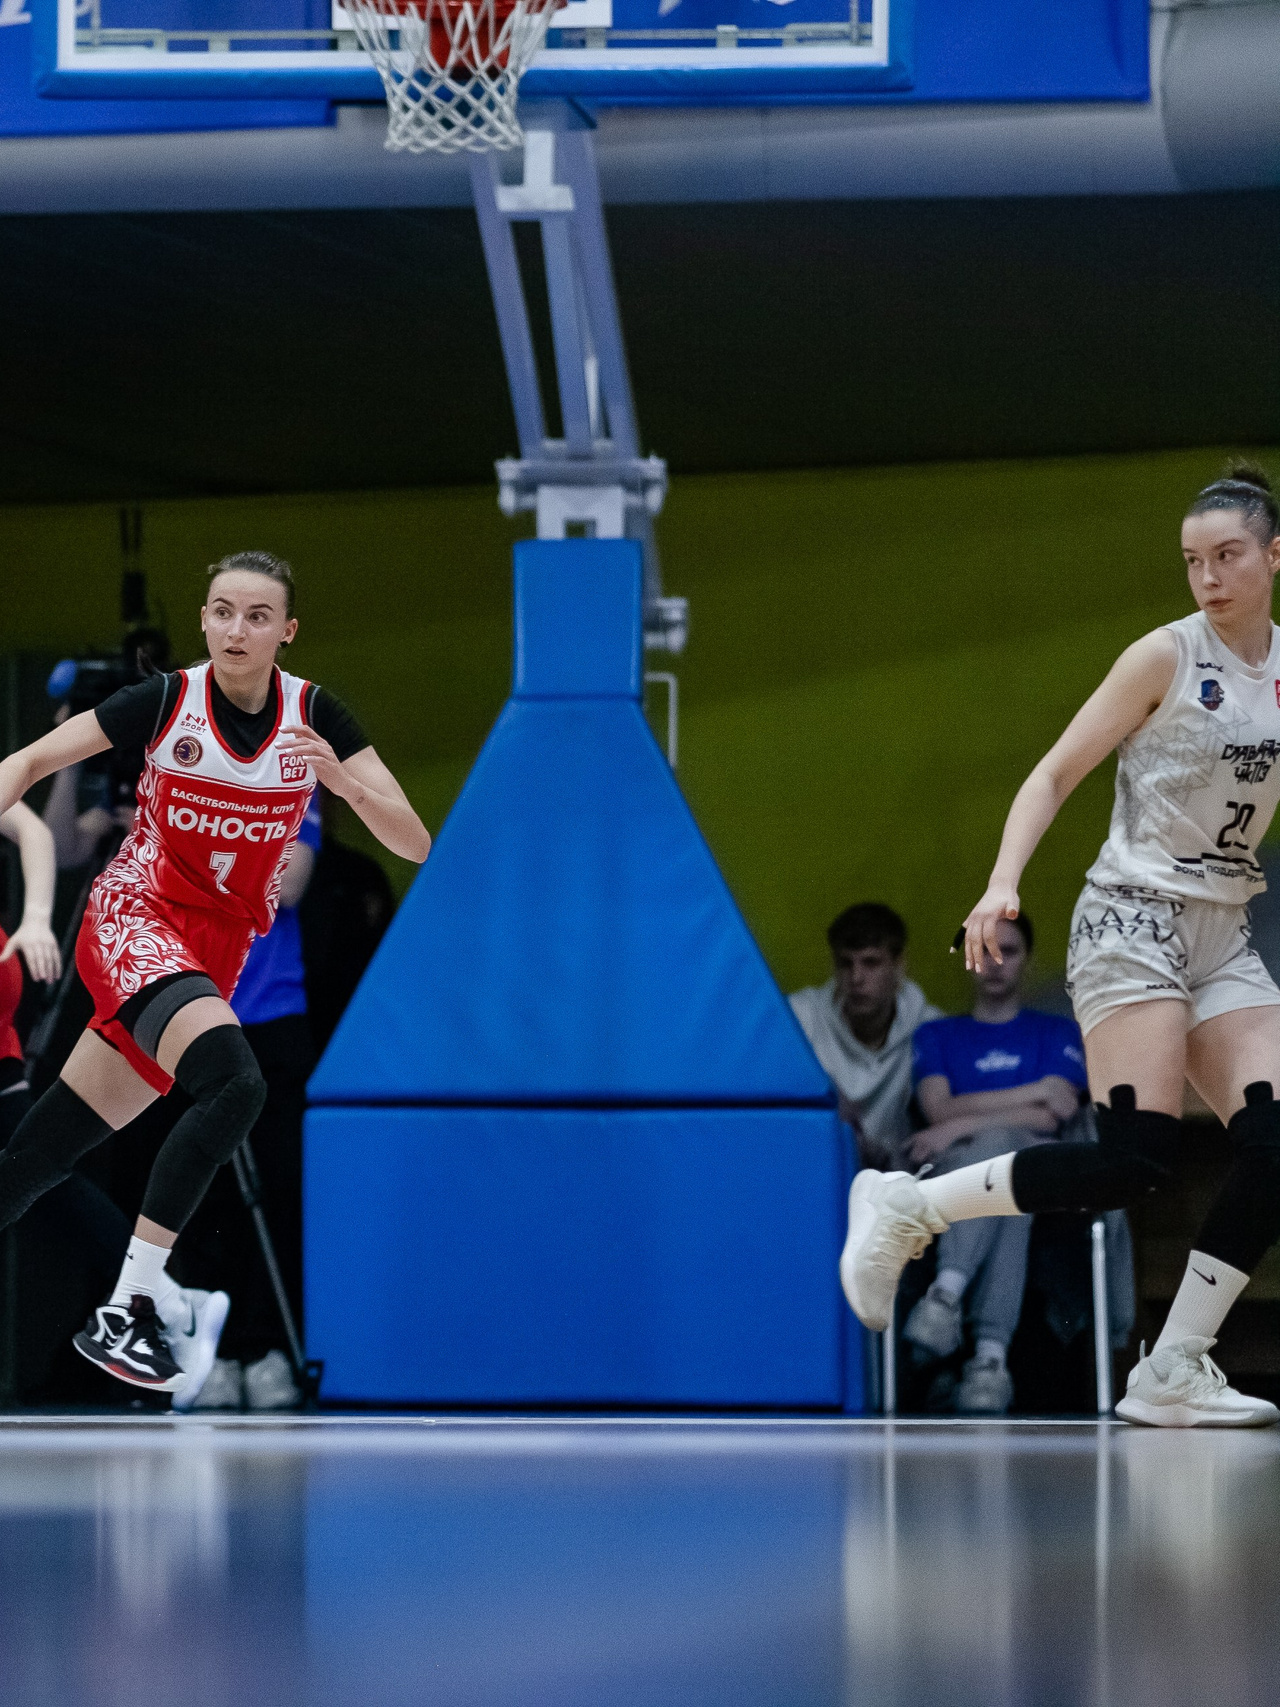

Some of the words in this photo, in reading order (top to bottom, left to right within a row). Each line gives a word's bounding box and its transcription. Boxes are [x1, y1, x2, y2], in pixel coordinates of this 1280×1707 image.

[180, 720, 208, 734] SPORT
[283, 766, 306, 779] BET
[170, 787, 269, 815] БАСКЕТБОЛЬНЫЙ
[271, 802, 296, 815] КЛУБ
[167, 804, 287, 843] ЮНОСТЬ
[1216, 800, 1256, 851] 20
[208, 851, 238, 894] 7
[1172, 864, 1205, 879] ФОНД
